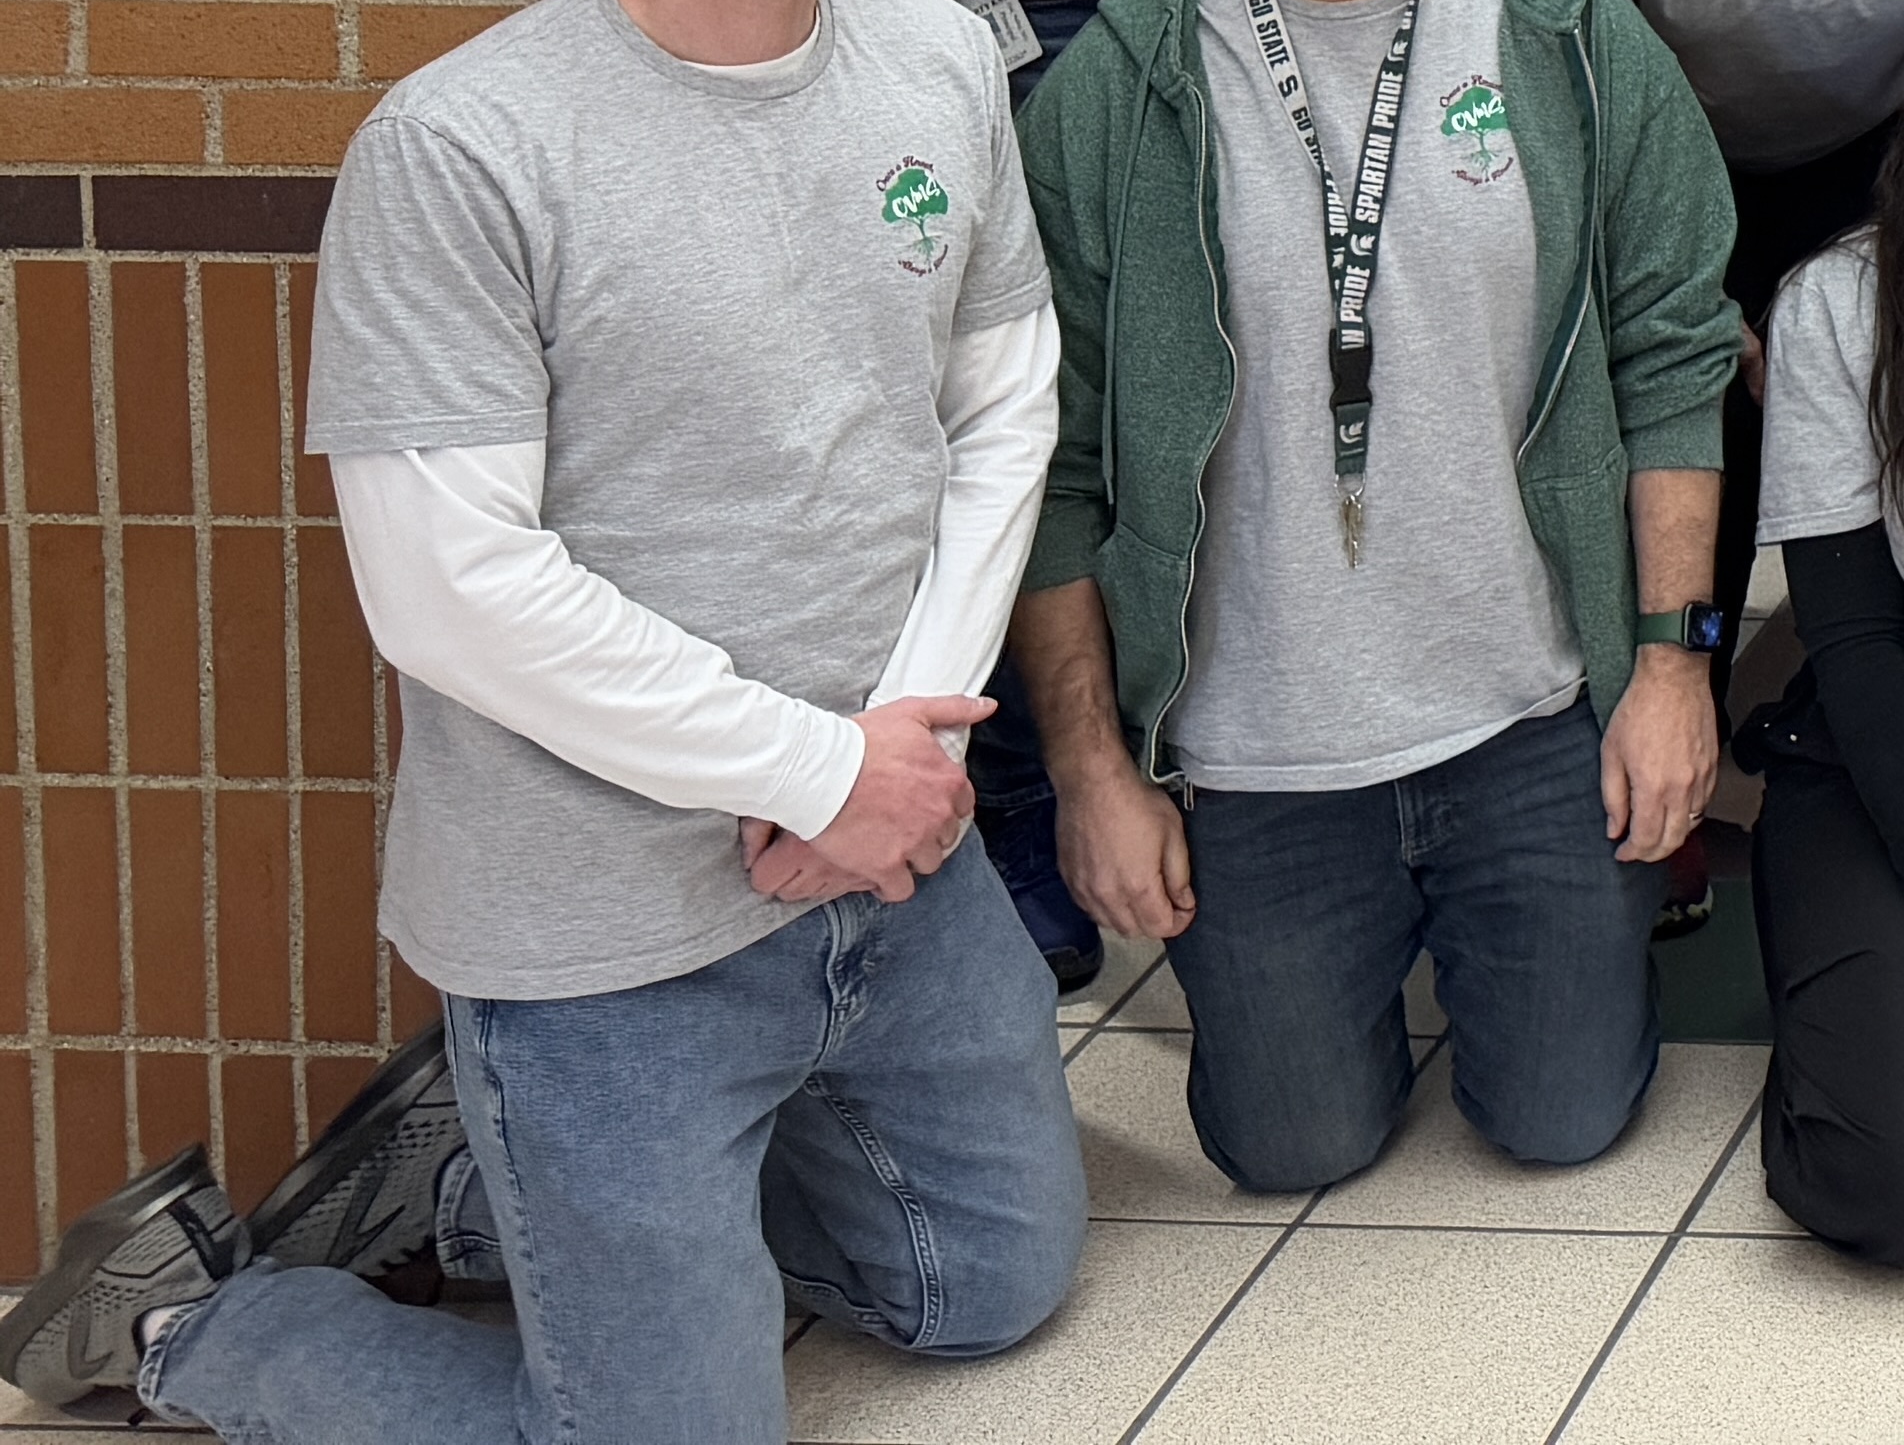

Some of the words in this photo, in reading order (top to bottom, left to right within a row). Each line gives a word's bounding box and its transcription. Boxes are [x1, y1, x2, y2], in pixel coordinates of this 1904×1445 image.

[1256, 19, 1290, 72] STATE
[1291, 105, 1313, 132] GO
[1372, 70, 1404, 130] PRIDE
[1354, 133, 1392, 225] SPARTAN
[1340, 265, 1371, 324] PRIDE
